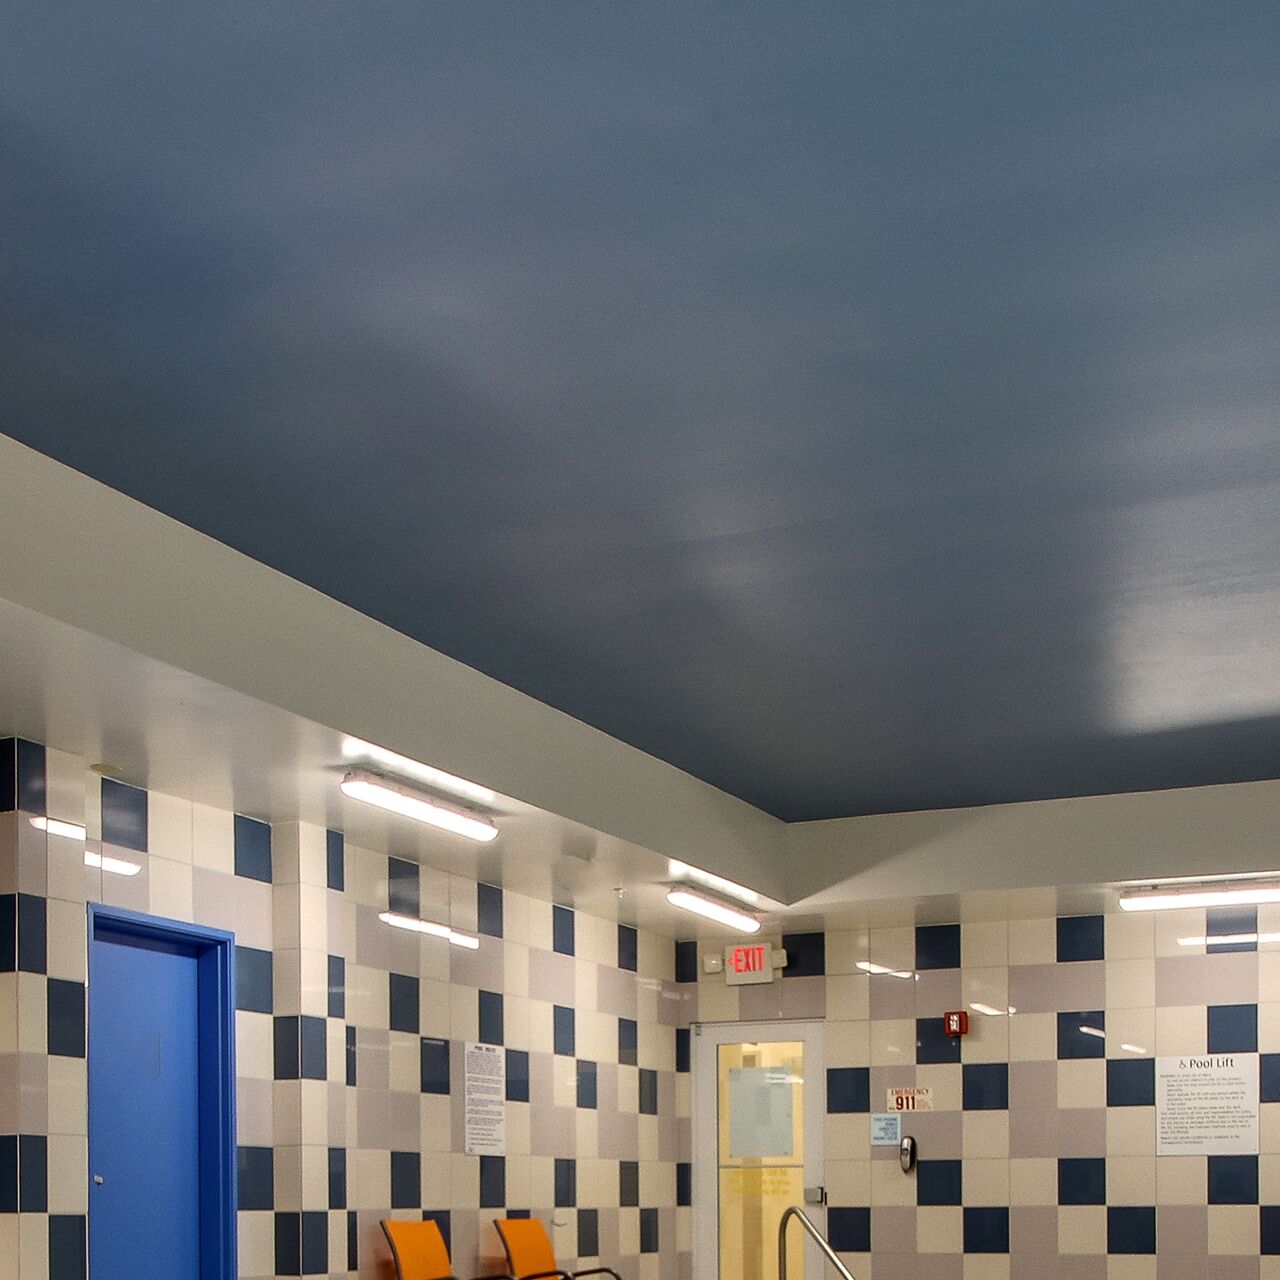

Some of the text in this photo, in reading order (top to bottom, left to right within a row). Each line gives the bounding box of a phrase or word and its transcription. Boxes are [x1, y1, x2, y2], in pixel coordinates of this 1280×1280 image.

[733, 946, 766, 973] EXIT
[1189, 1057, 1234, 1068] Pool Lift
[891, 1087, 929, 1096] EMERGENCY
[895, 1096, 916, 1110] 911
